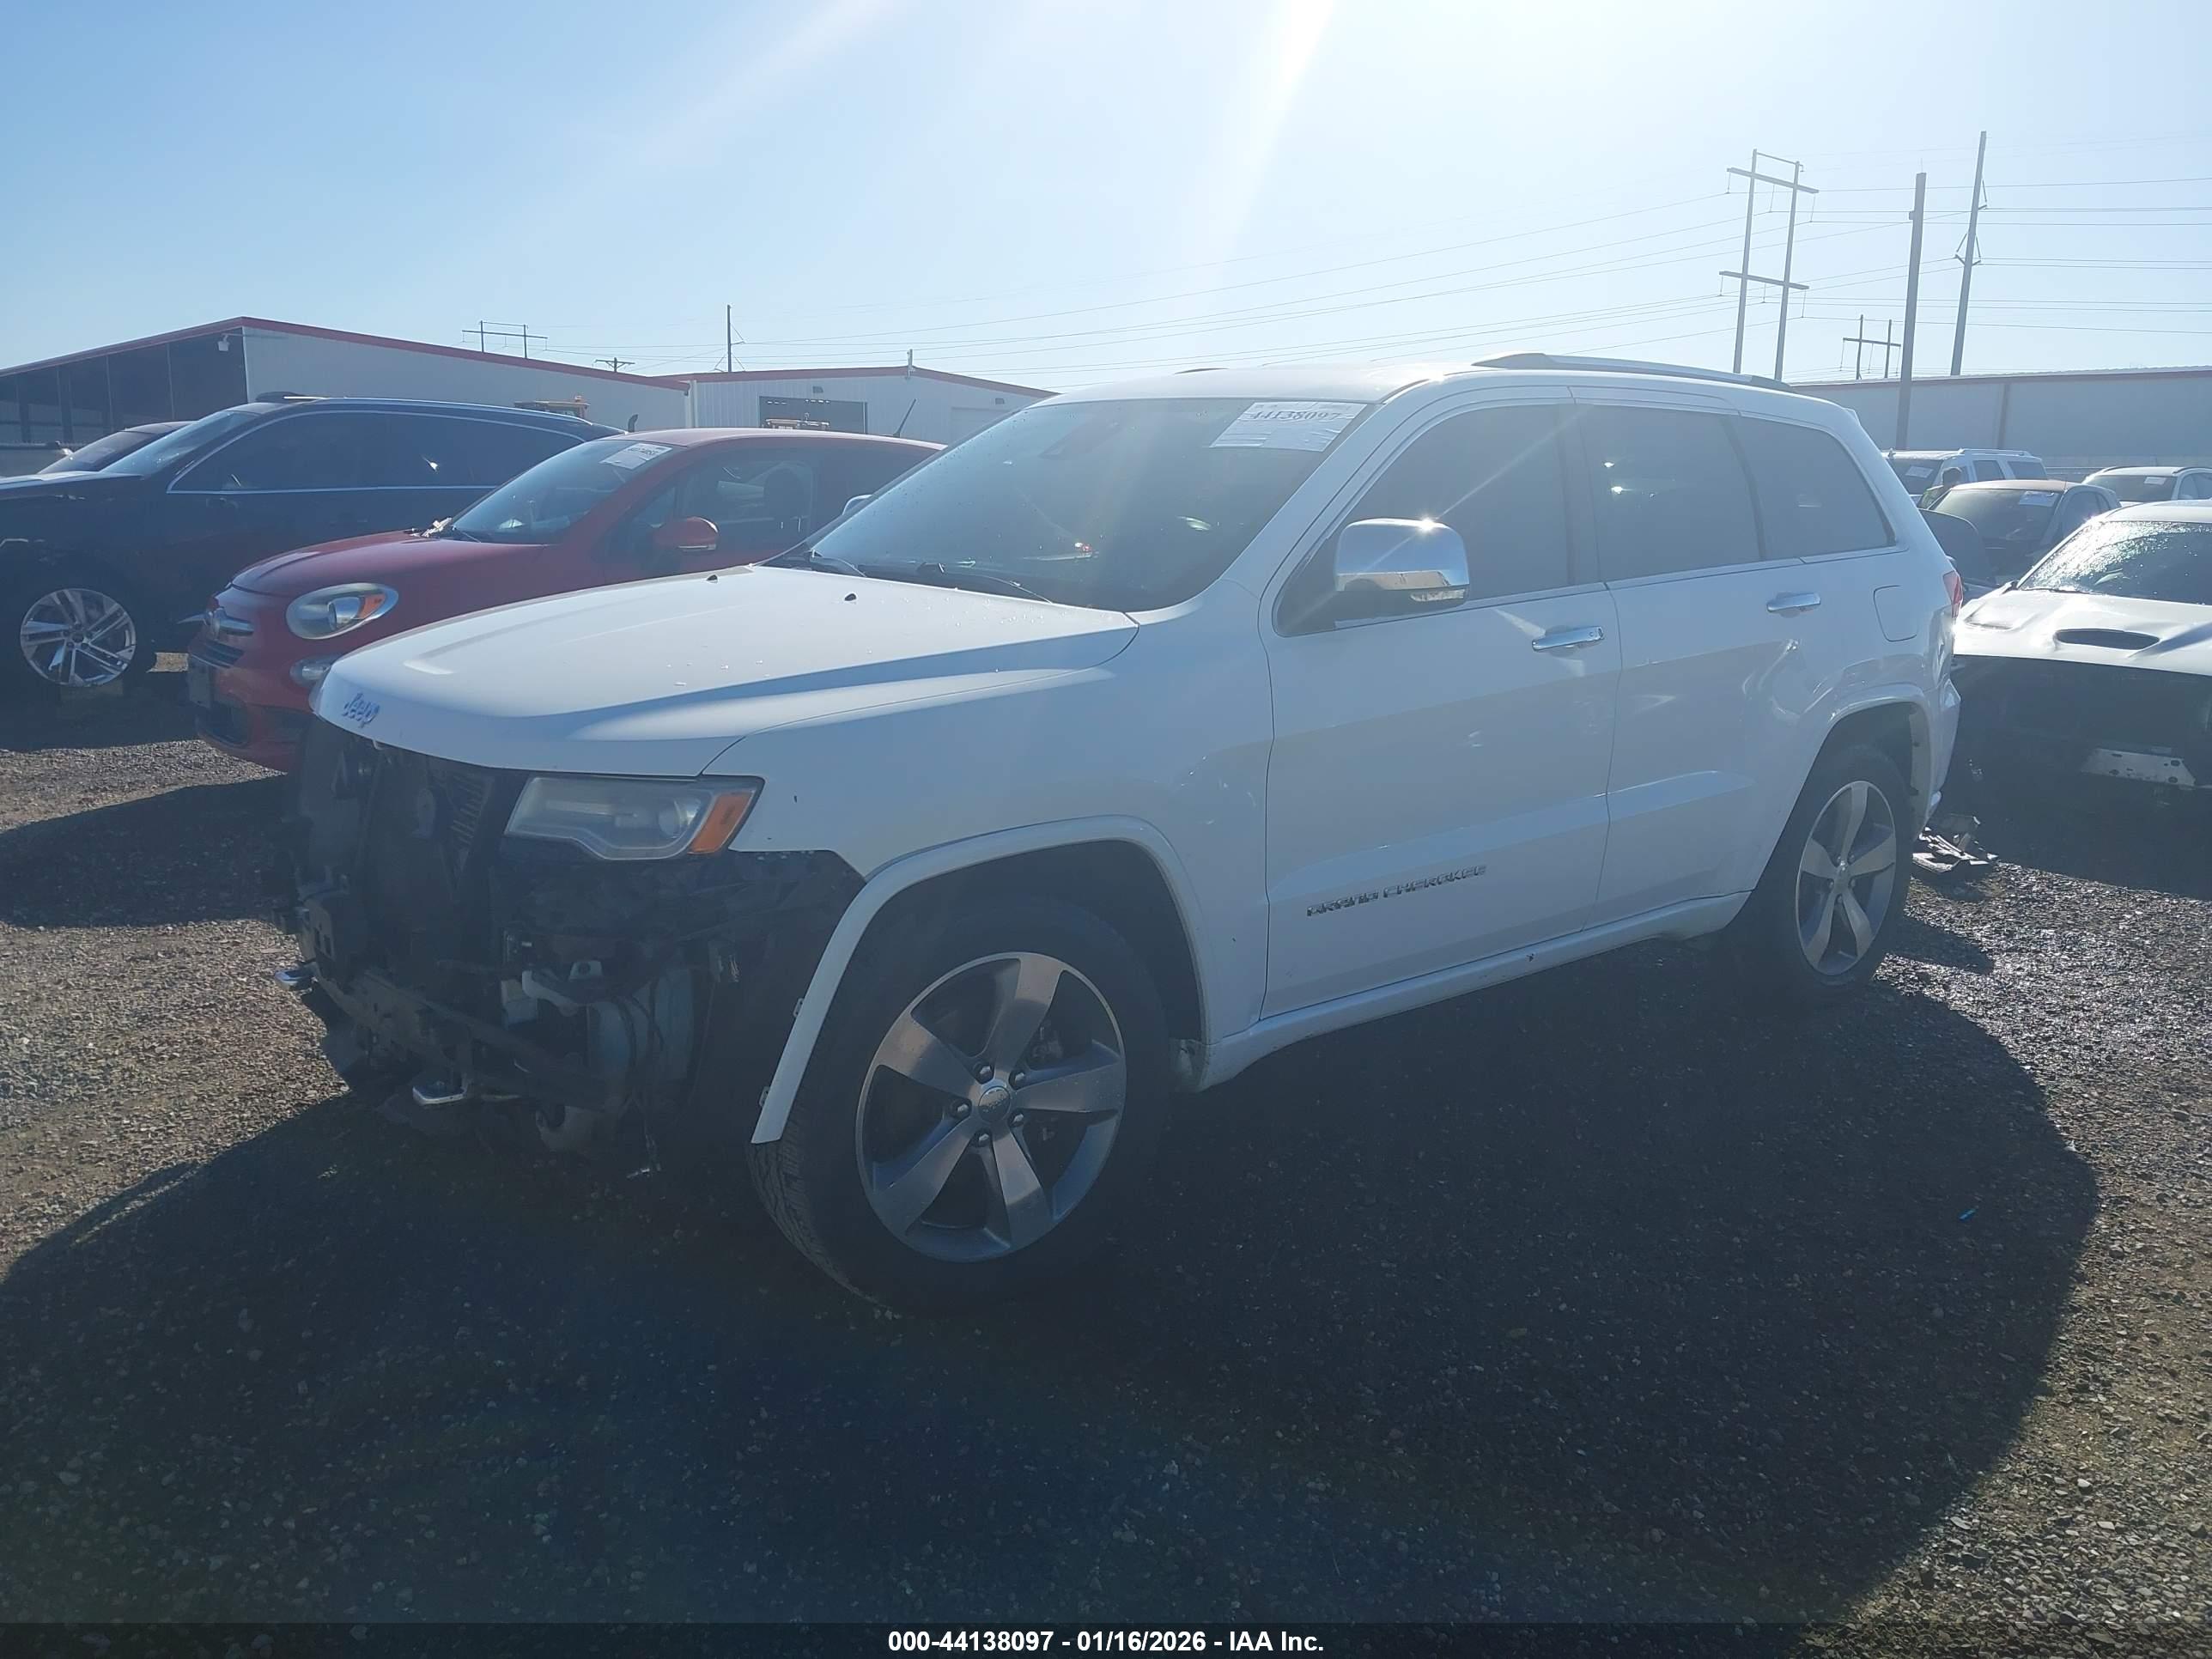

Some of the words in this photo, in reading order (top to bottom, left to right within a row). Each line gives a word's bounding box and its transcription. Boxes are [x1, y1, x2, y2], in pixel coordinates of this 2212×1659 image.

[1250, 410, 1344, 421] 44138097
[342, 692, 380, 728] Jeep
[1306, 891, 1379, 917] GRAND
[1383, 865, 1486, 898] CHEROKEE
